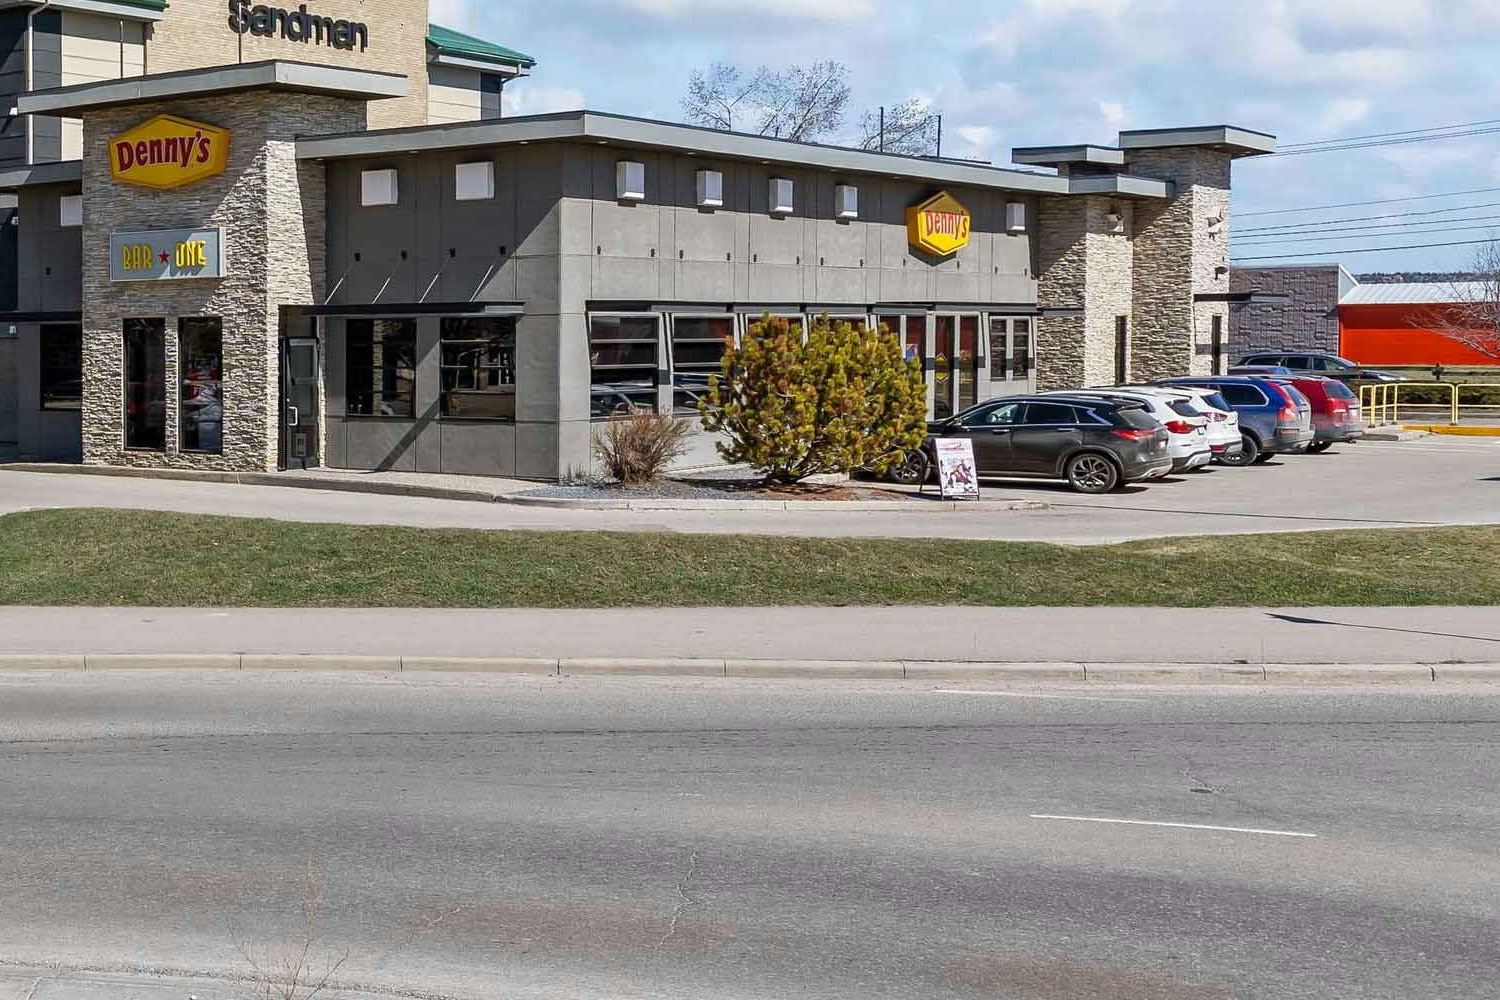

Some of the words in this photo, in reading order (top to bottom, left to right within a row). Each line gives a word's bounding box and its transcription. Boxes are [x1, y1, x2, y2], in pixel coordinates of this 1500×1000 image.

[116, 130, 212, 172] Denny's
[924, 209, 968, 241] Denny's
[123, 243, 153, 271] BAR
[175, 239, 208, 268] ONE
